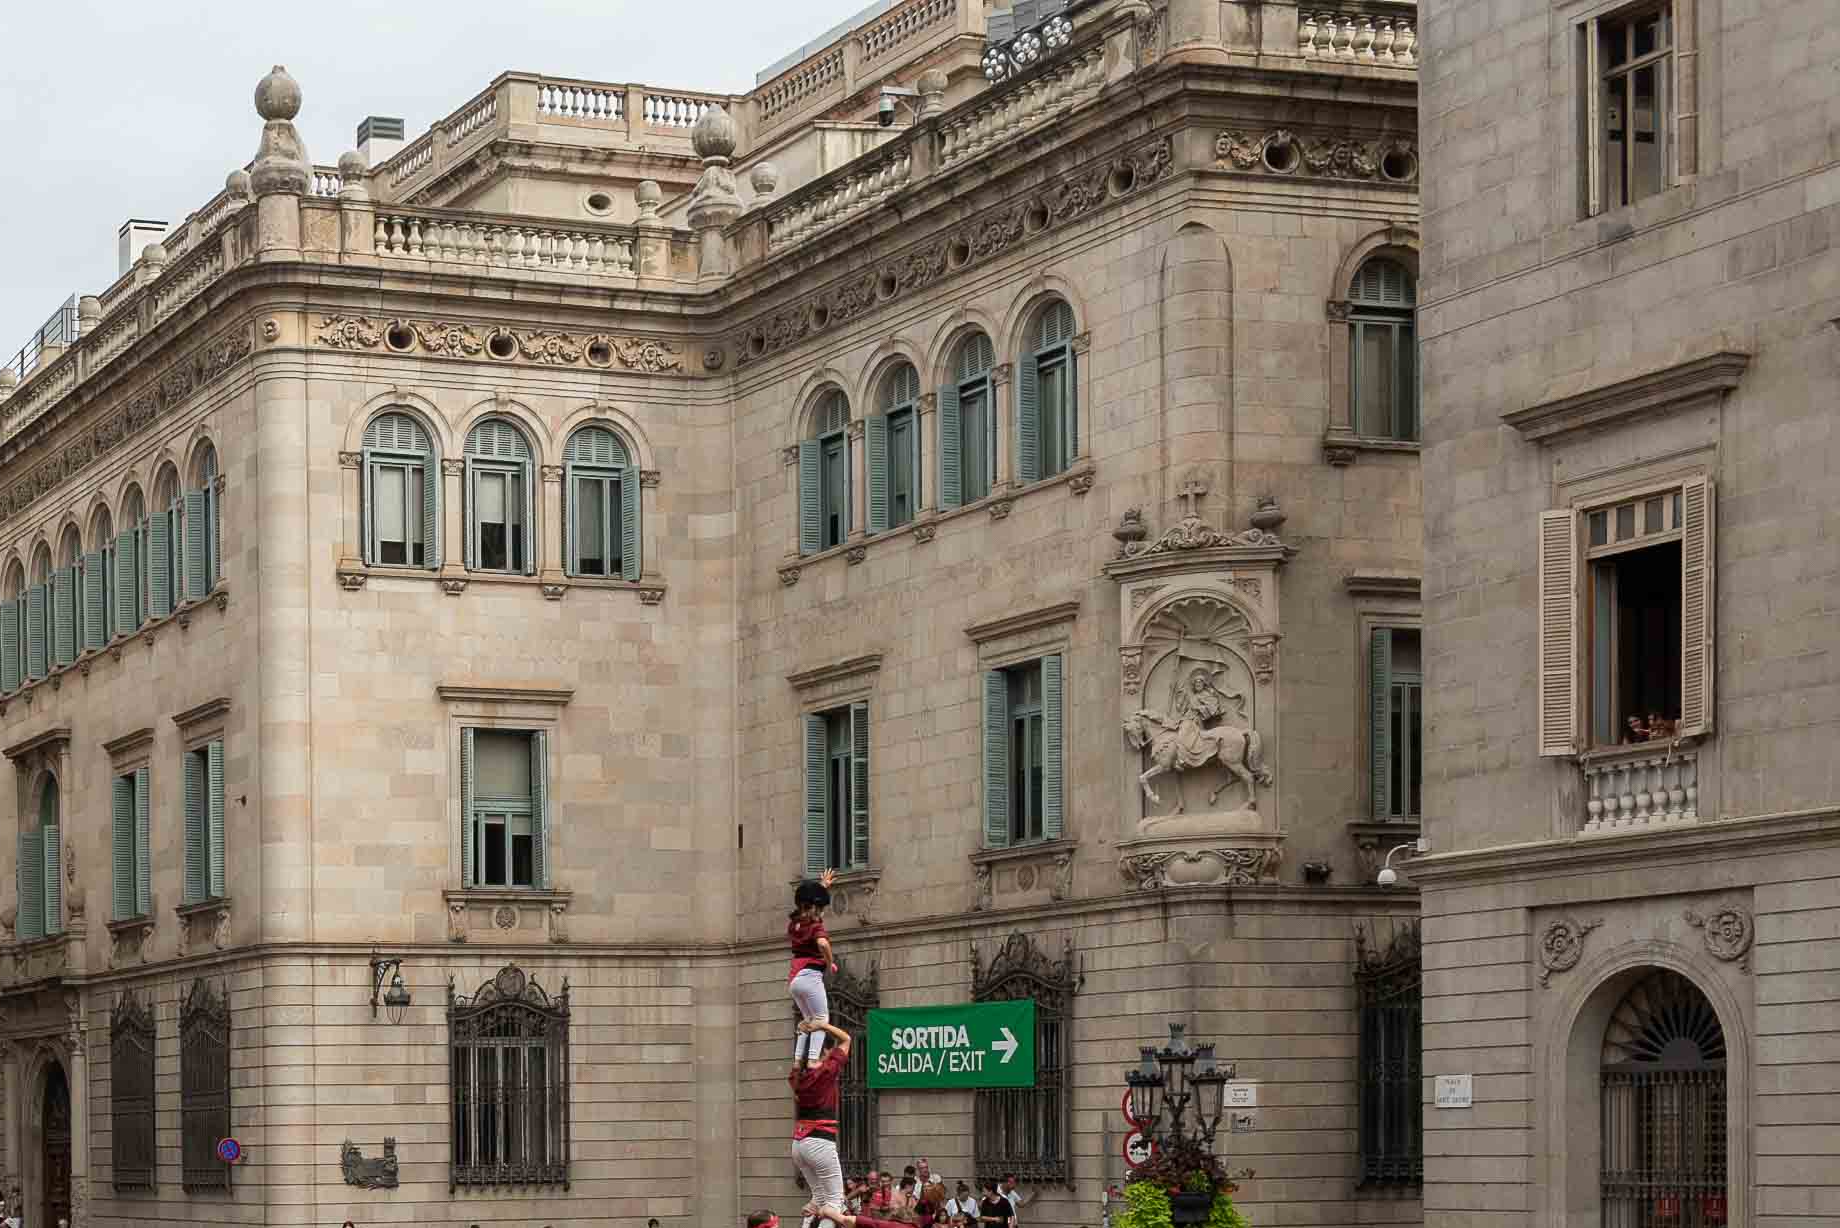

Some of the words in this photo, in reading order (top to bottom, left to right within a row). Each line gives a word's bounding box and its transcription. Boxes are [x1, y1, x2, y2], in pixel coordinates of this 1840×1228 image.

[891, 1024, 970, 1050] SORTIDA
[878, 1053, 934, 1074] SALIDA
[937, 1050, 946, 1076] /
[949, 1051, 986, 1073] EXIT
